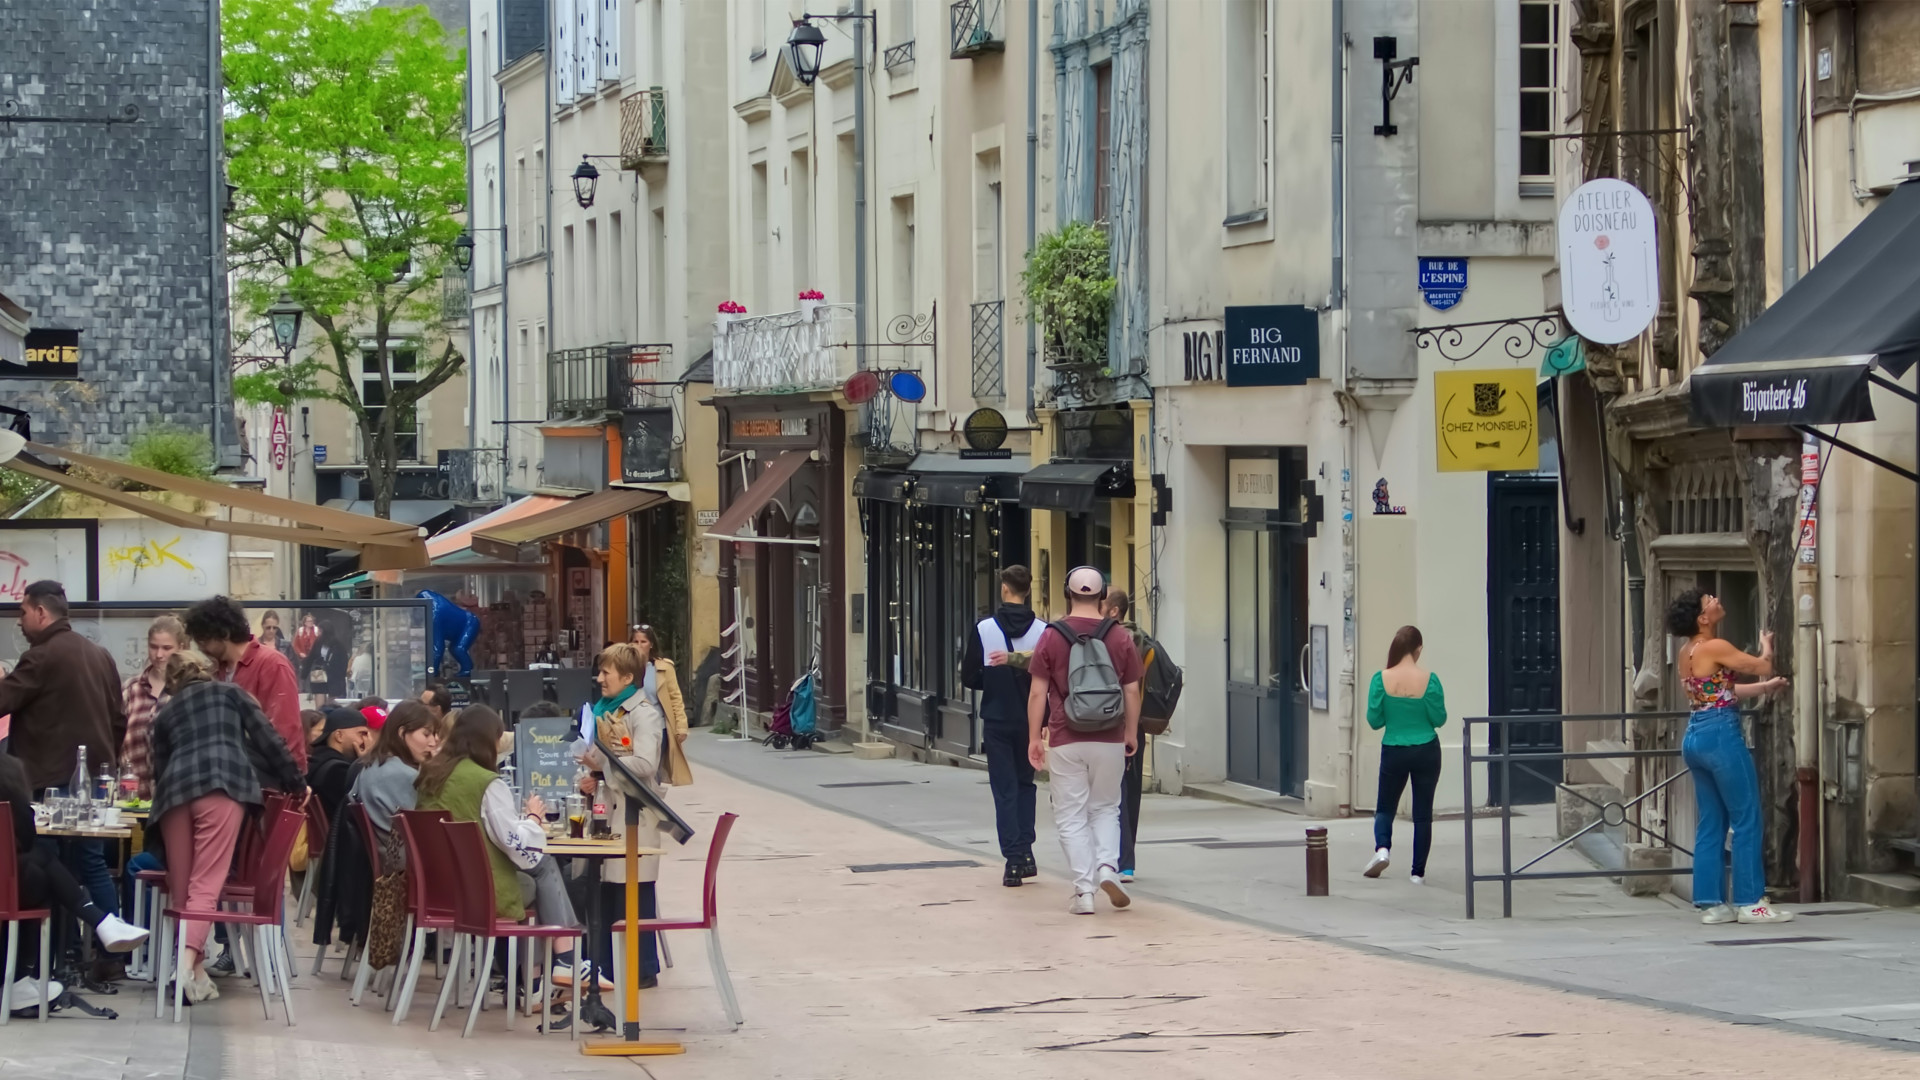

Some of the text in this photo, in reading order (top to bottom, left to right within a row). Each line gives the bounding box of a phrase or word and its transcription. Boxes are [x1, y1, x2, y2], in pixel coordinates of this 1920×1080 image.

[1578, 190, 1631, 211] ATELIER
[1574, 211, 1637, 233] DOISNEAU
[1428, 261, 1459, 271] RUE DE
[1422, 272, 1465, 283] L'ESPINE
[1250, 327, 1282, 344] BIG
[25, 345, 60, 363] ard
[1183, 330, 1213, 381] BIG
[1232, 346, 1301, 365] FERNAND
[1742, 379, 1807, 422] Bijouterie 46
[1446, 420, 1527, 433] CHEZ MONSIEUR
[272, 412, 287, 465] TABAC
[530, 771, 569, 786] Plat du
